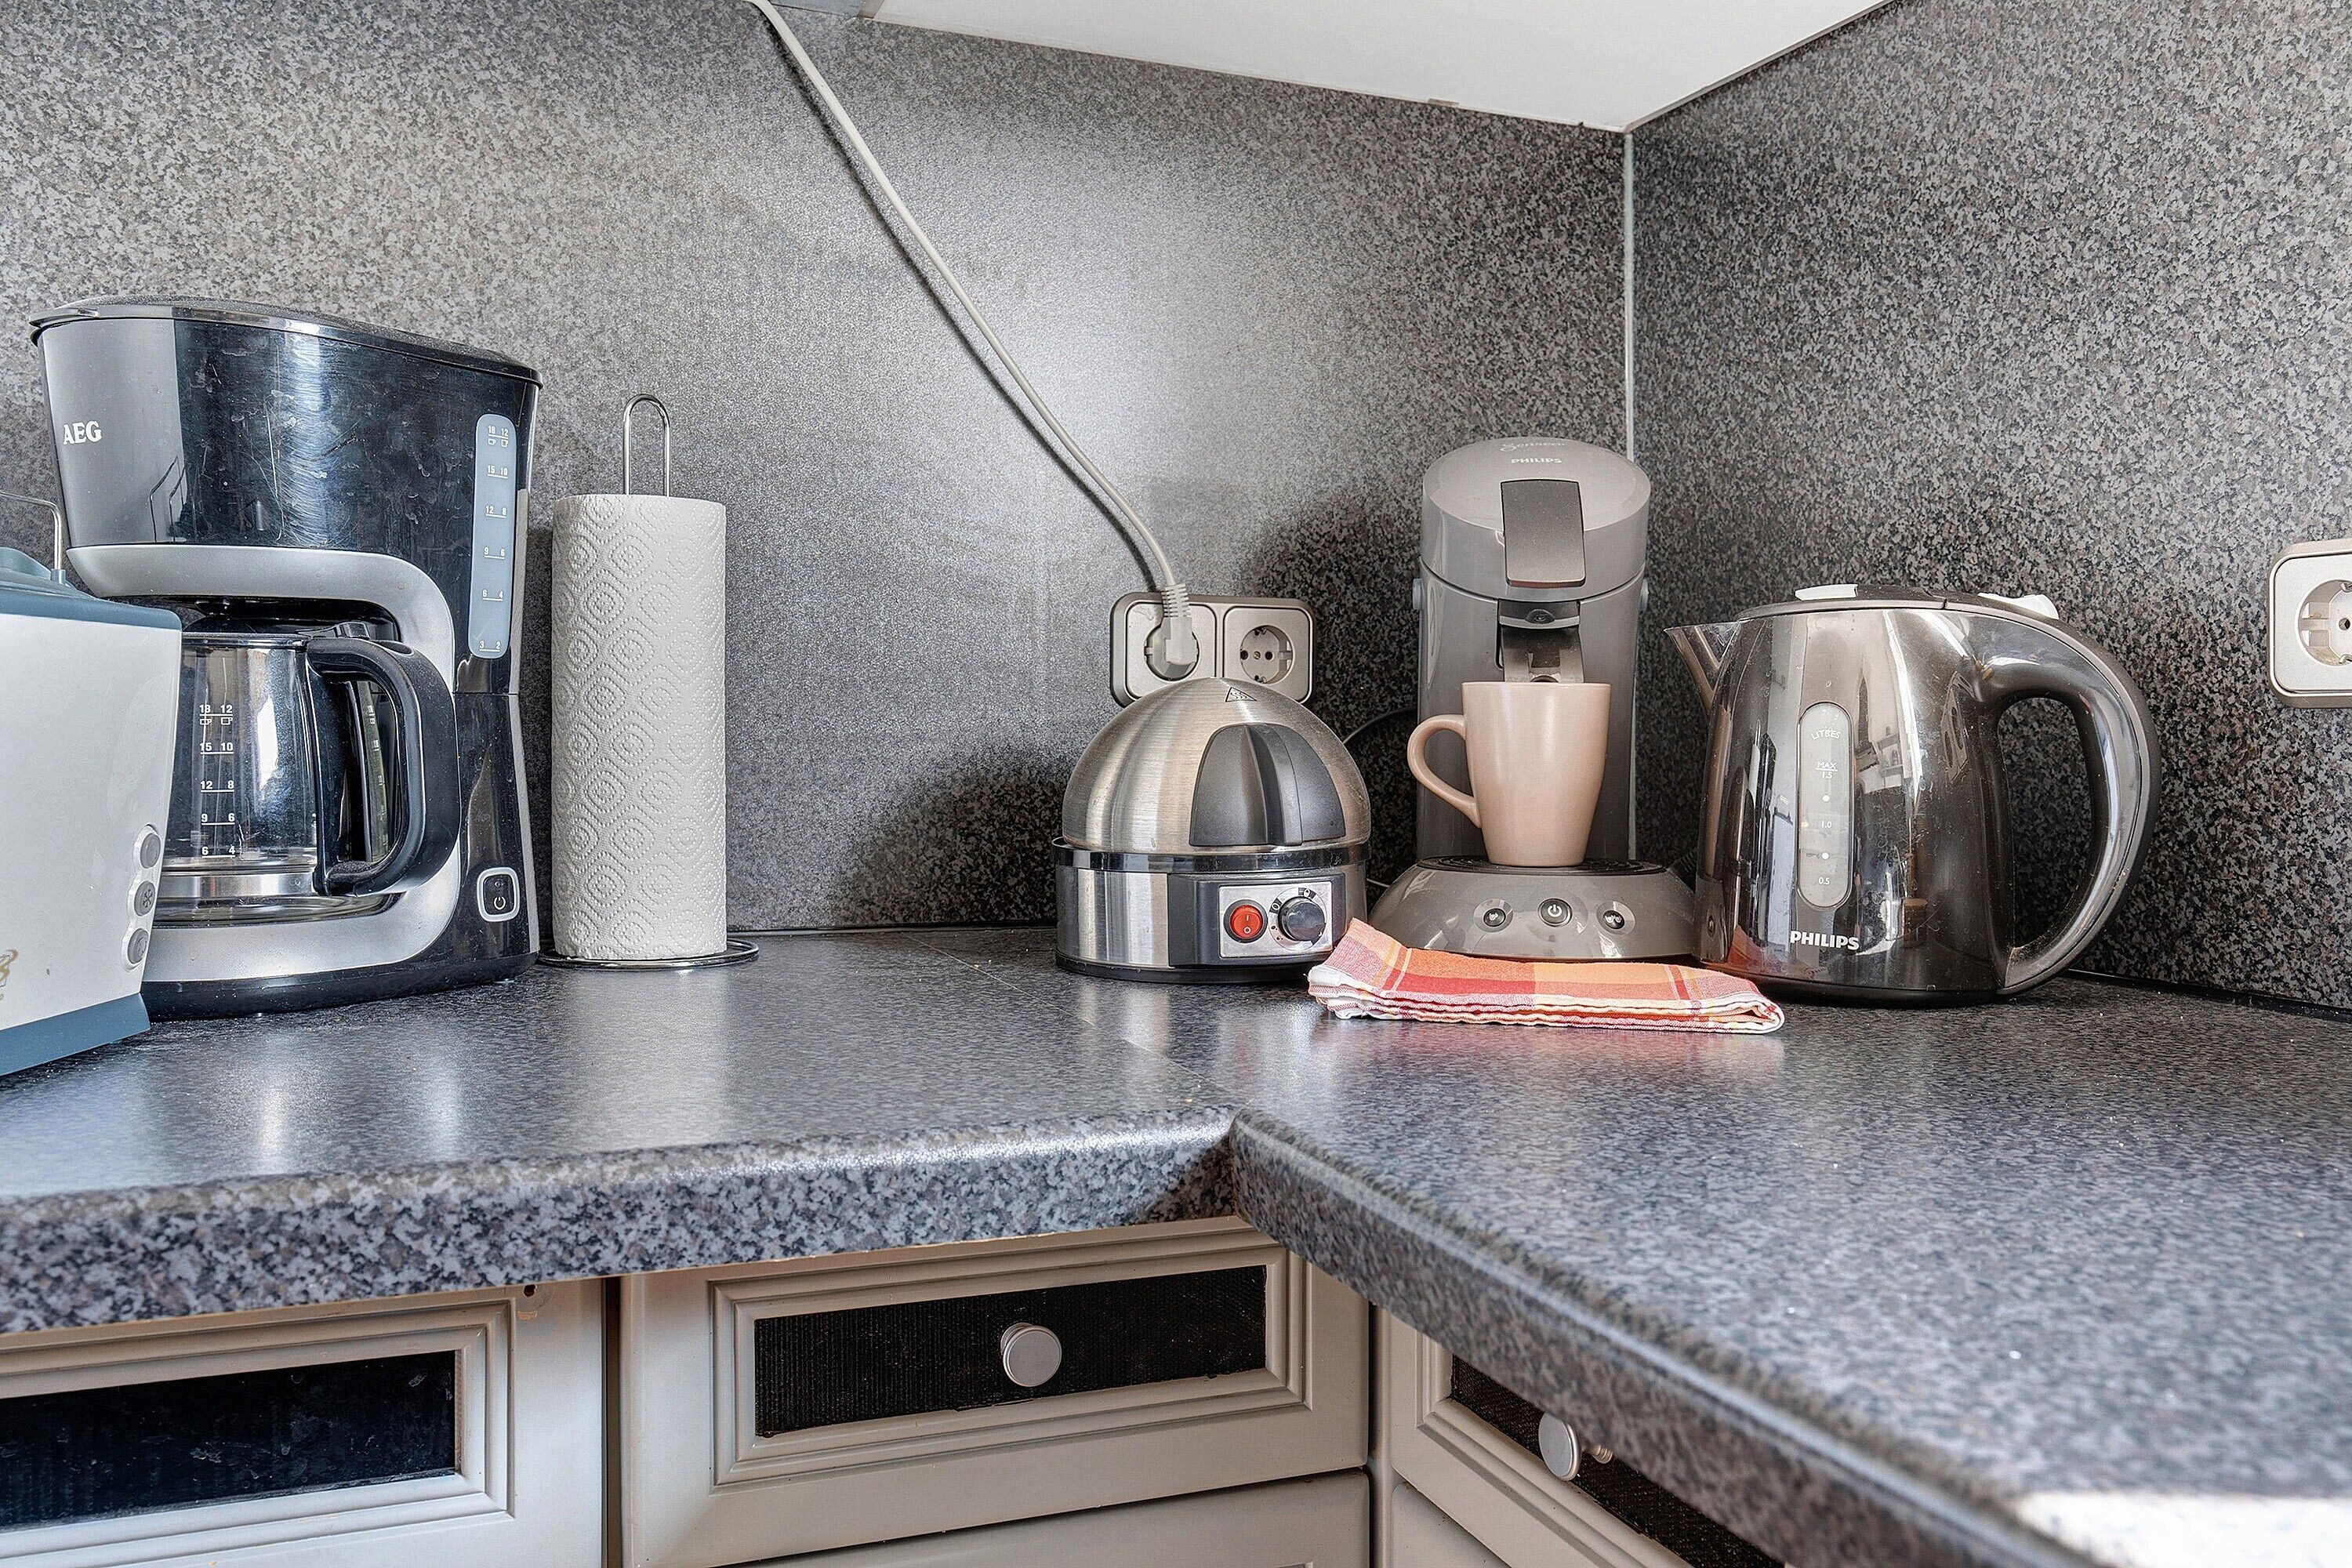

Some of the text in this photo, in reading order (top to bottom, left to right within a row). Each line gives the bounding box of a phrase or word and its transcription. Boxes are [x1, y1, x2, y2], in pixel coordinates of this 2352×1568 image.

[63, 420, 103, 445] AEG
[488, 425, 508, 437] 18 12
[488, 465, 508, 476] 15 10
[485, 505, 494, 514] 12
[484, 546, 505, 557] 9 6
[482, 589, 488, 597] 6
[479, 640, 501, 649] 3 2
[199, 705, 233, 714] 18 12
[1810, 728, 1842, 740] LITRES
[199, 742, 234, 752] 15 10
[200, 780, 234, 789] 12 8
[201, 812, 235, 822] 9 6
[201, 846, 235, 855] 6 4
[1818, 877, 1831, 885] 0.5
[1789, 930, 1860, 950] PHILIPS
